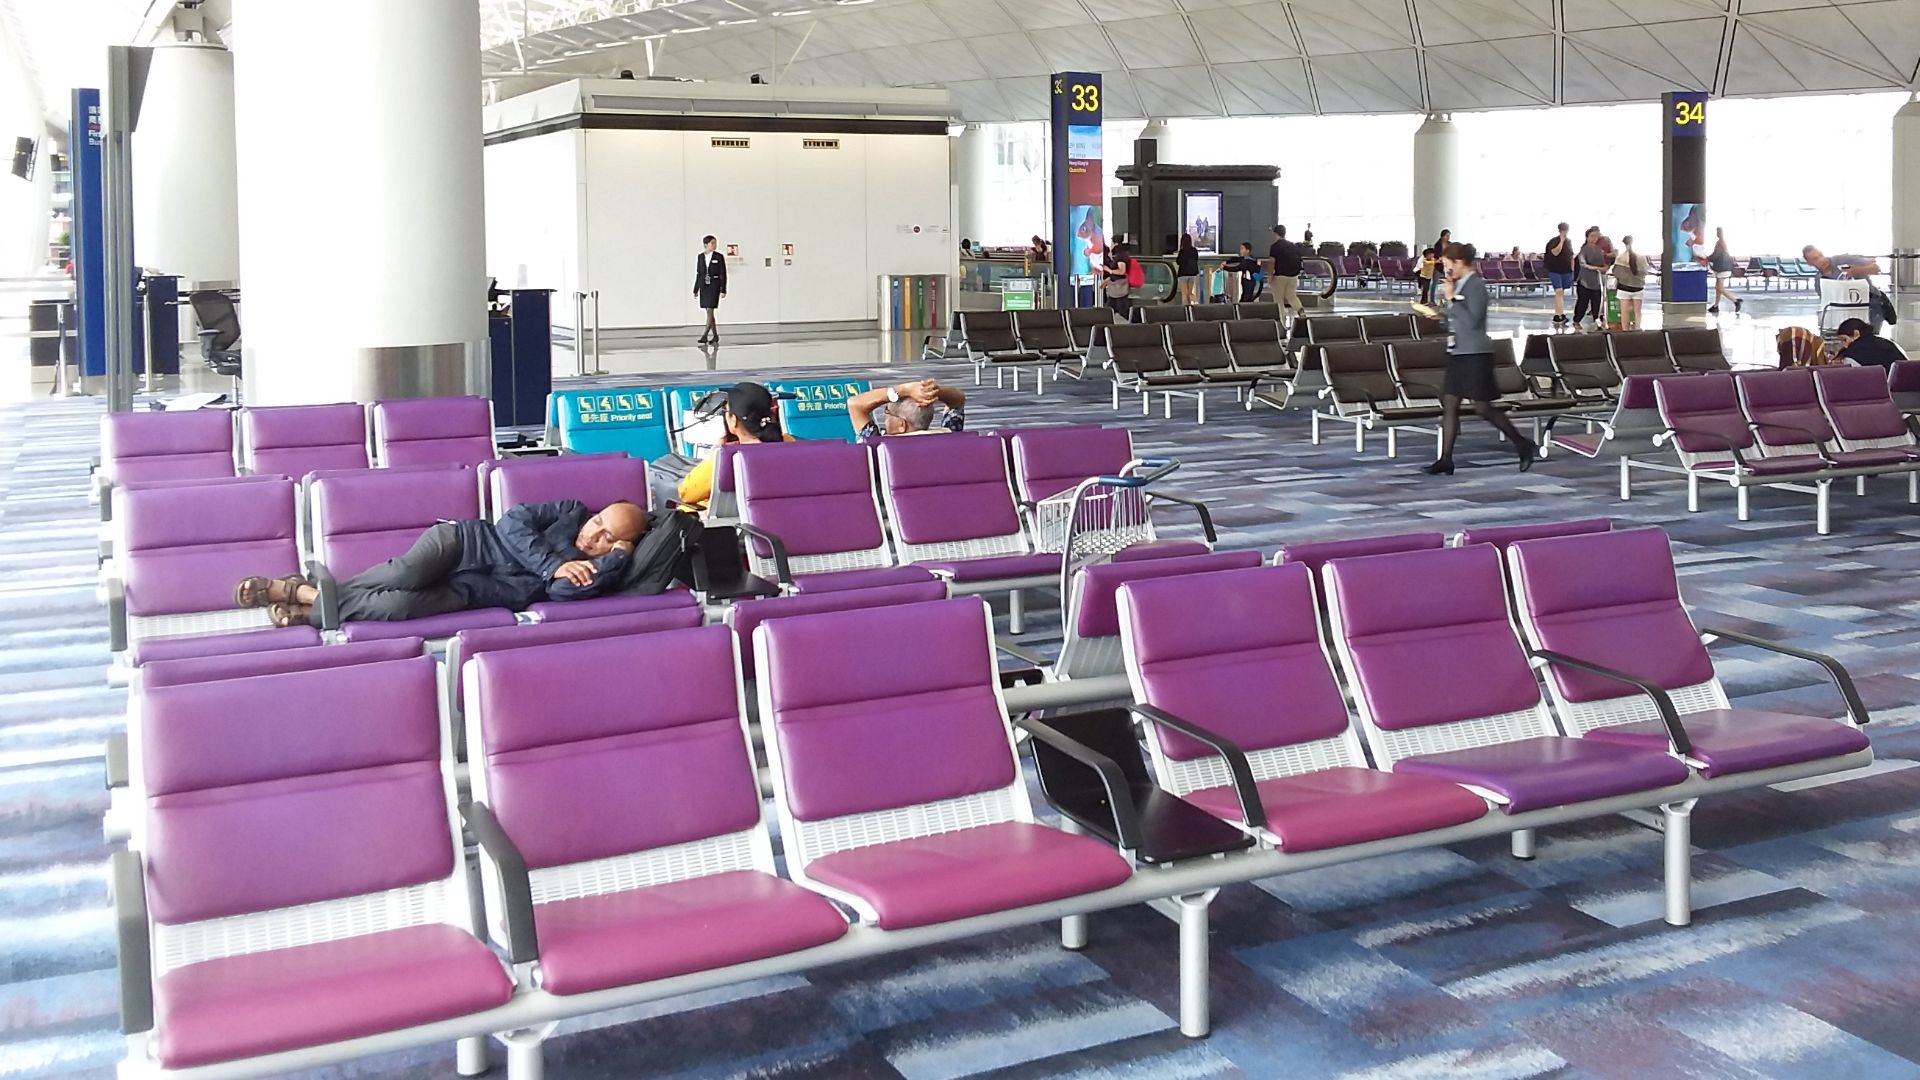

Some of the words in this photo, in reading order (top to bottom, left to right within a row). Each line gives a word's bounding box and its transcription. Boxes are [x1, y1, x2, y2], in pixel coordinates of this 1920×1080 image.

[1071, 84, 1099, 112] 33
[1675, 101, 1705, 125] 34
[824, 402, 847, 411] Priority
[611, 413, 636, 422] Priority
[637, 412, 653, 420] seat
